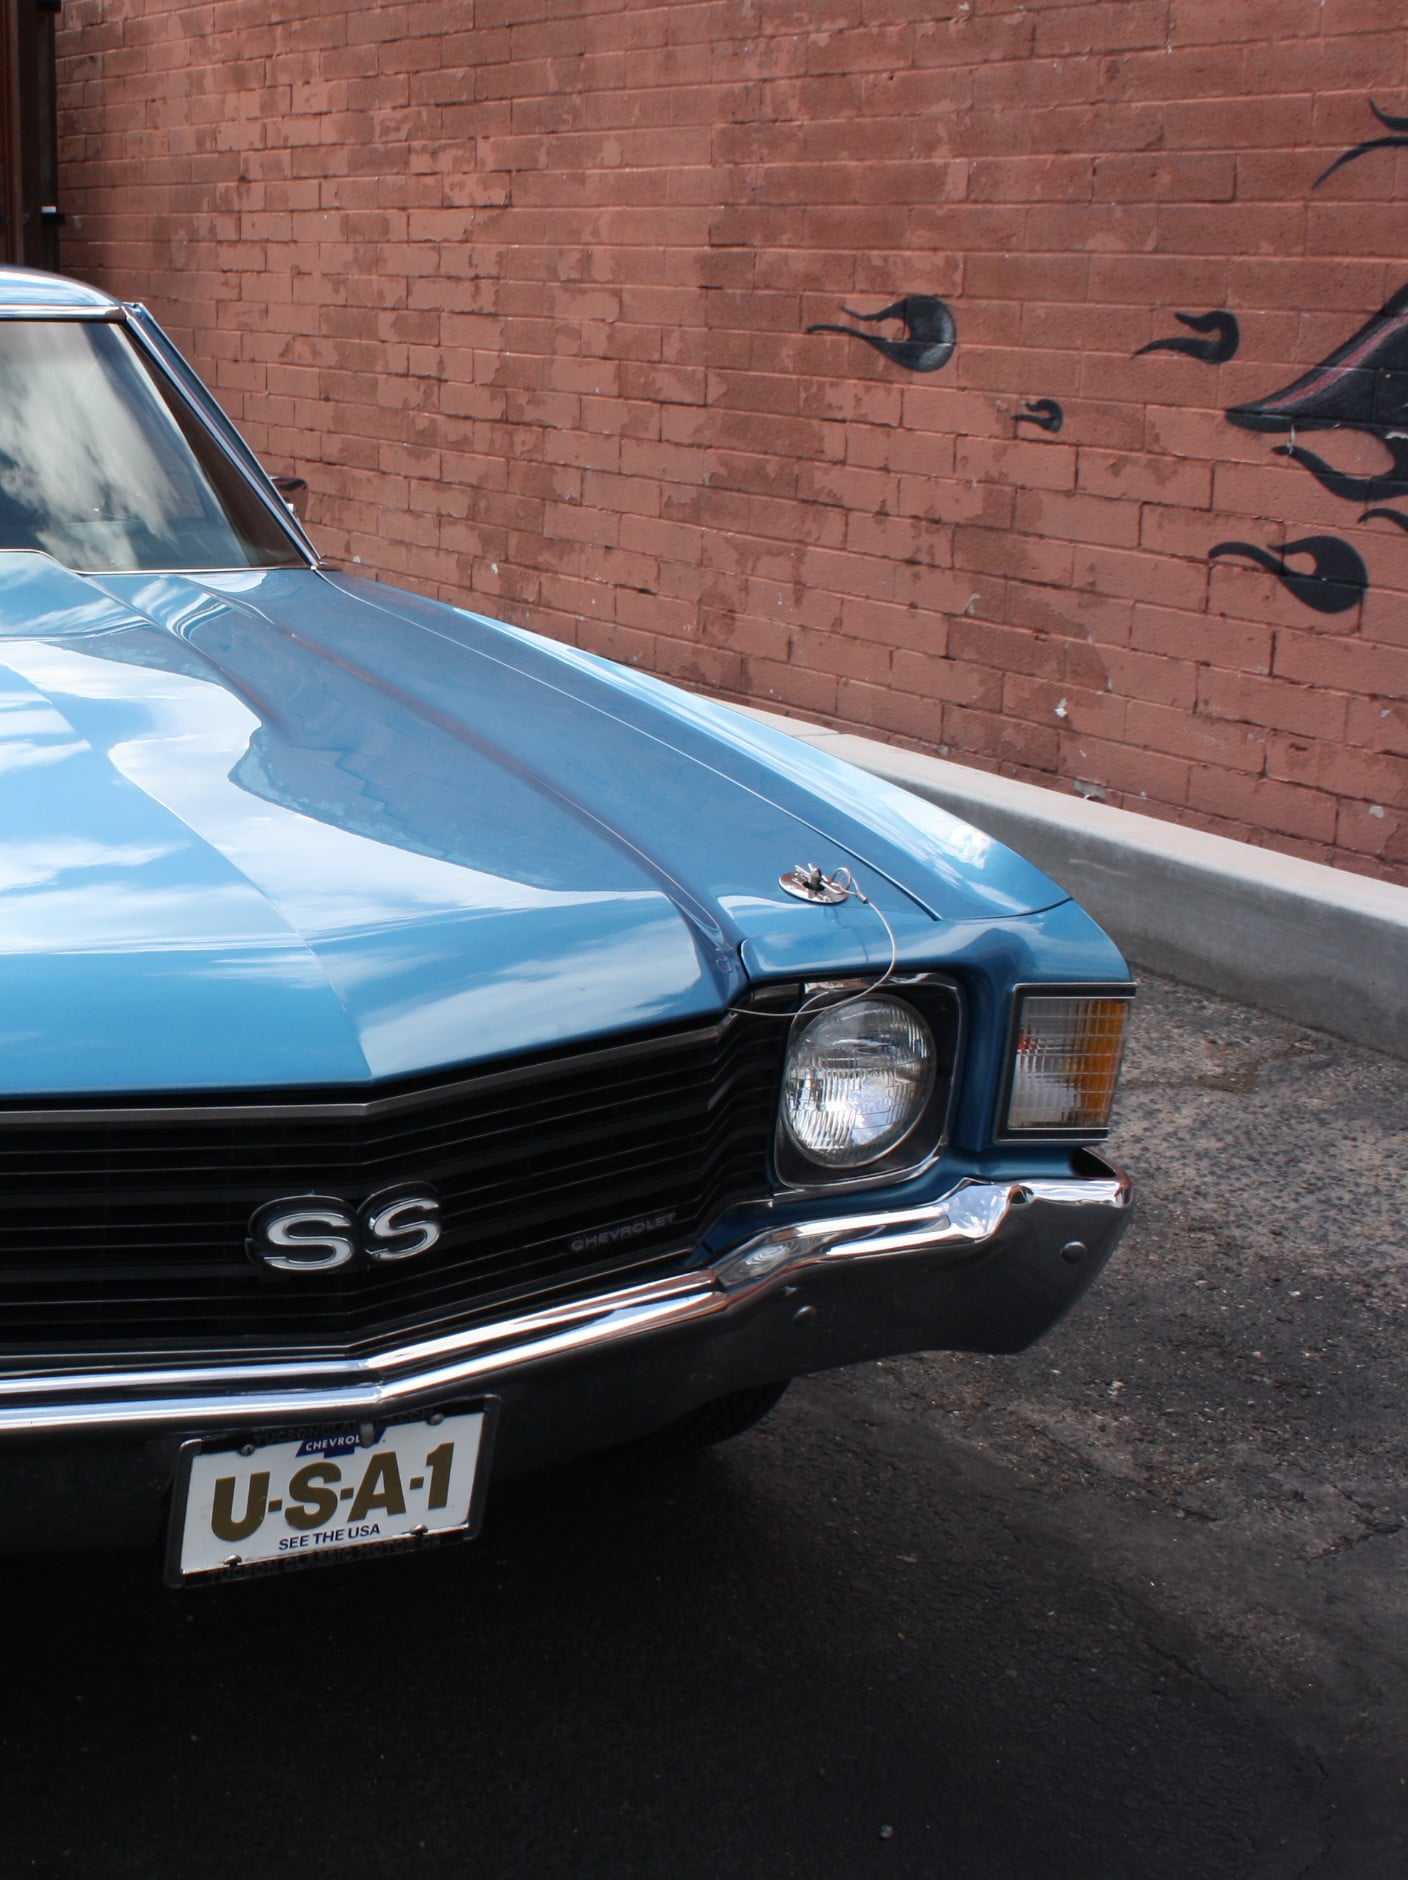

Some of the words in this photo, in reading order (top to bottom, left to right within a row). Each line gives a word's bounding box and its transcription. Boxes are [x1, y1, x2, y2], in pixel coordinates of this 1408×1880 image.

[263, 1197, 441, 1271] SS
[571, 1212, 676, 1251] CHEVROLET
[305, 1434, 361, 1452] CHEVROL
[210, 1441, 455, 1542] U-S-A-1
[278, 1534, 309, 1551] SEE
[311, 1529, 345, 1546] THE
[347, 1523, 381, 1538] USA
